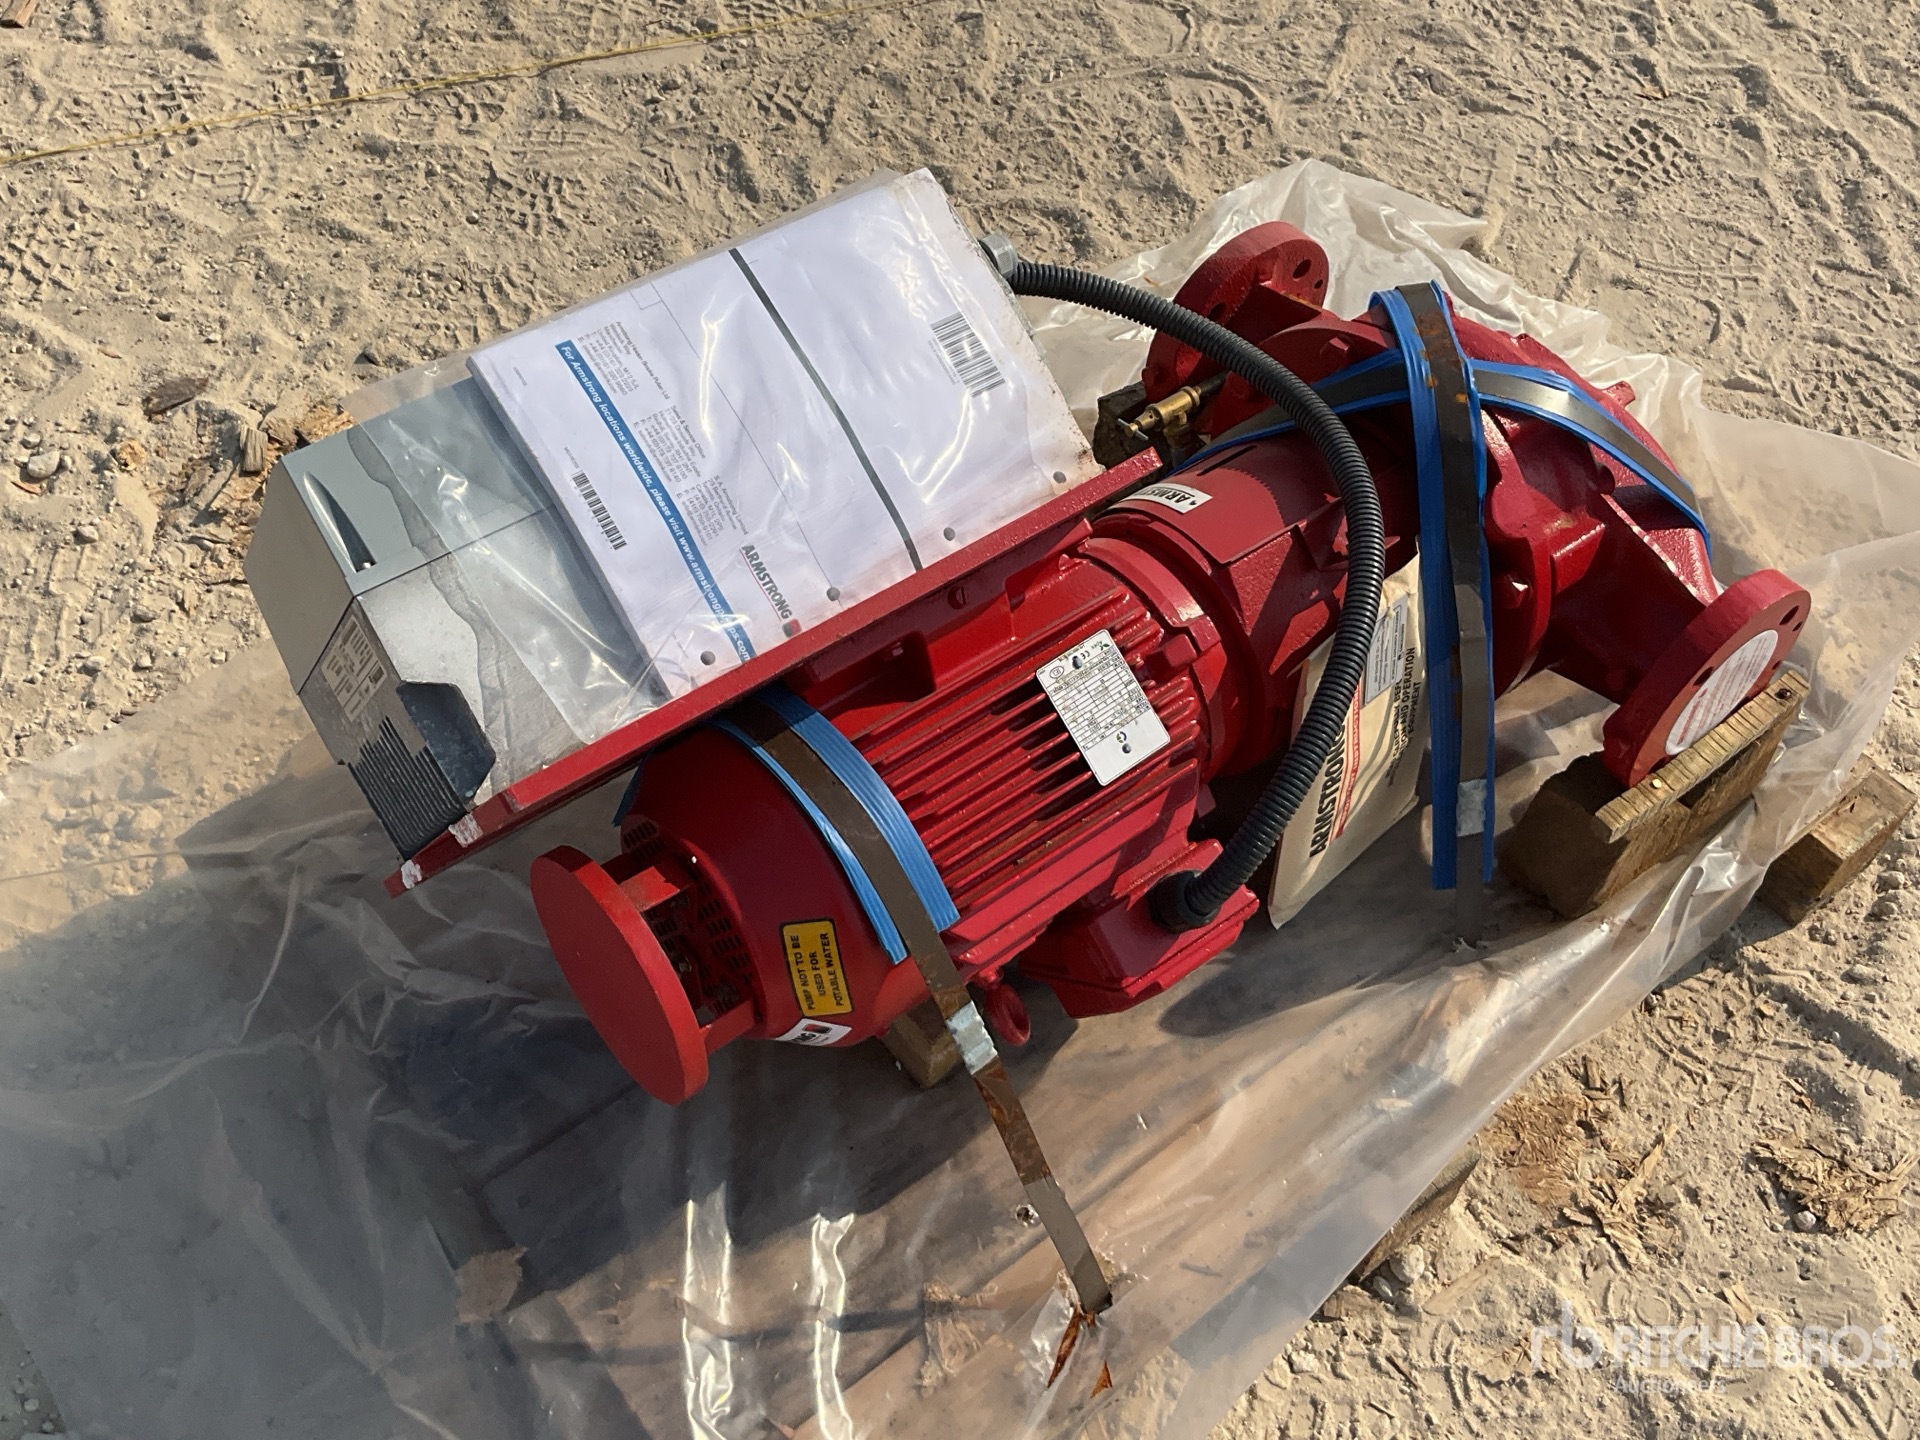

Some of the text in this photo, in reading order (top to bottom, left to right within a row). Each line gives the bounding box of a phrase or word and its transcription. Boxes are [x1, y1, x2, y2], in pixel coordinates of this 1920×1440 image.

[682, 423, 697, 443] Service
[693, 442, 707, 459] Office
[689, 460, 701, 477] Estate
[560, 345, 573, 360] For
[569, 362, 601, 402] Armstrong
[597, 402, 626, 441] locations
[623, 441, 652, 487] worldwide,
[648, 490, 671, 516] please
[668, 516, 684, 535] visit
[678, 535, 750, 661] www.armstrongpps.com
[740, 546, 793, 620] ARMSTRONG
[1079, 649, 1091, 660] CE
[1400, 647, 1415, 724] AND OPERATION
[1407, 681, 1421, 733] EQUIPMENT
[790, 935, 815, 1010] PUMP NOT TO BE
[809, 951, 826, 996] USED FOR
[820, 933, 844, 1006] POTABLE WATER
